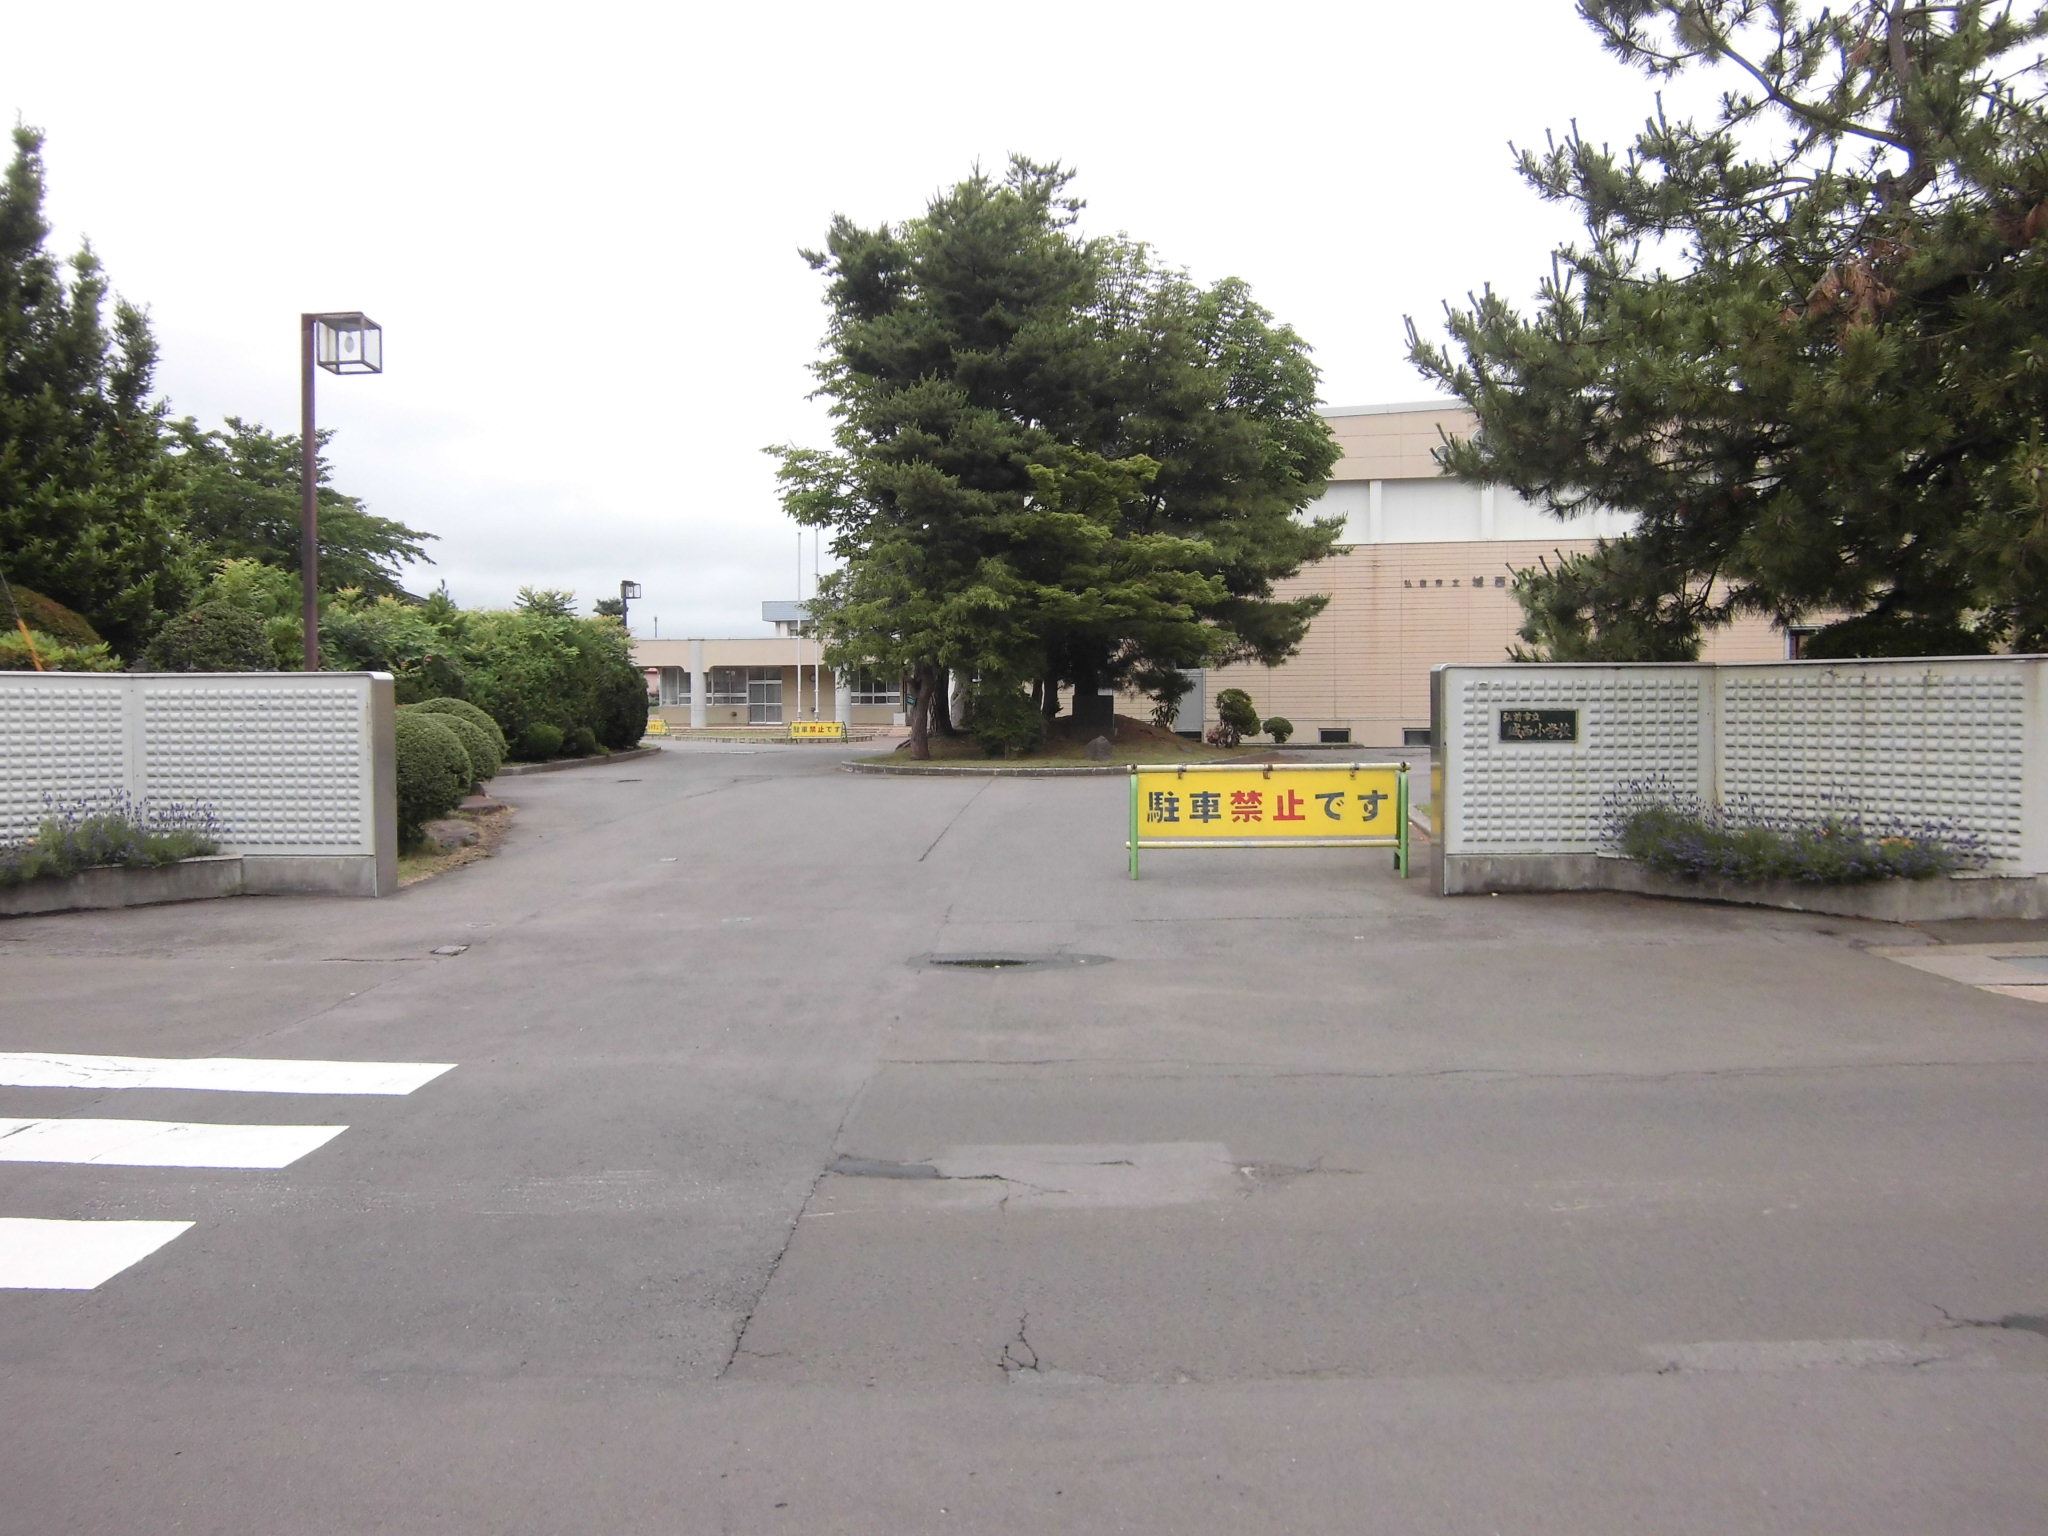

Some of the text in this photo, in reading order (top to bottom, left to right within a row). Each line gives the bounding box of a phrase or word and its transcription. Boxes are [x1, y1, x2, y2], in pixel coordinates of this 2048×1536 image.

[1146, 789, 1389, 824] 駐車禁止です
